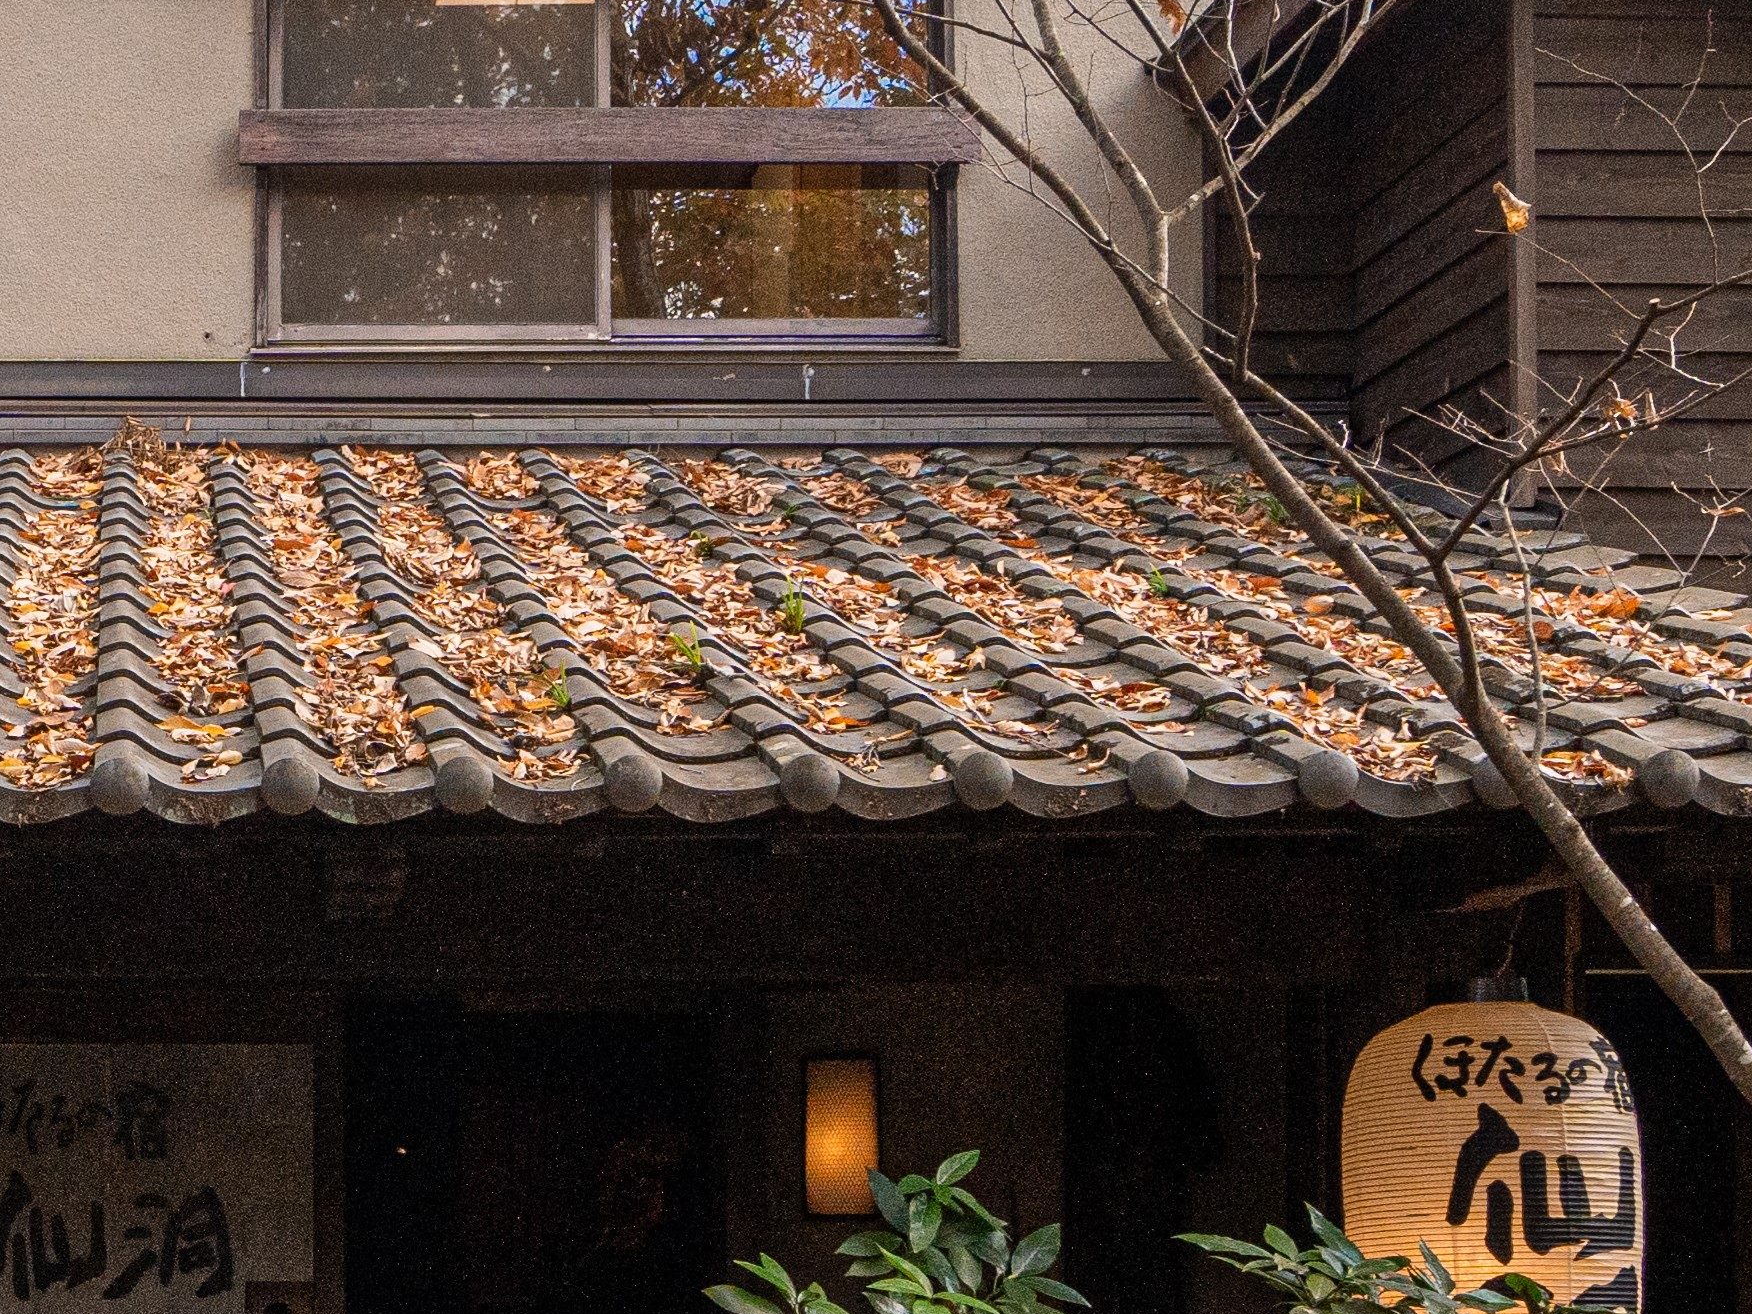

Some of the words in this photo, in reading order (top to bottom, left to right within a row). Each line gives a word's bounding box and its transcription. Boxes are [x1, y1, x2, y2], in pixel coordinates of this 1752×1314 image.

[1412, 1033, 1634, 1114] ほたるの宿
